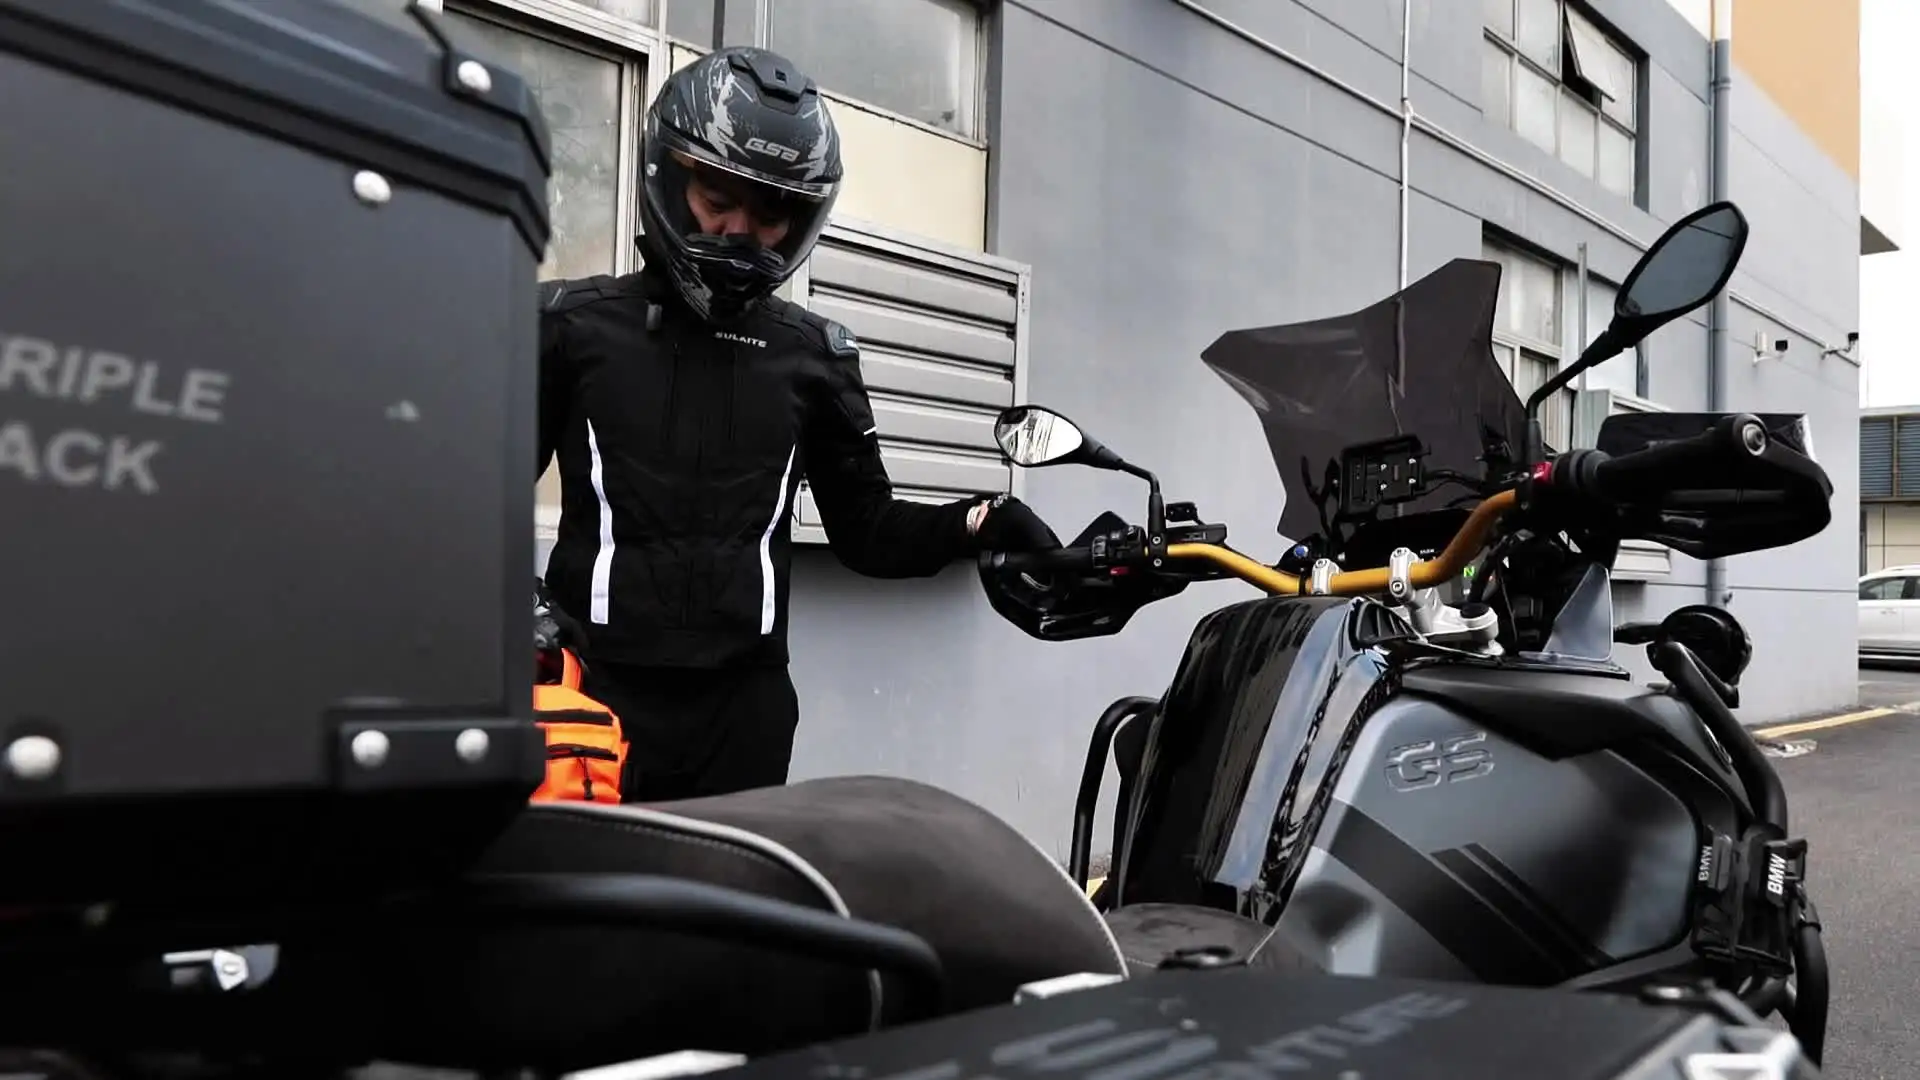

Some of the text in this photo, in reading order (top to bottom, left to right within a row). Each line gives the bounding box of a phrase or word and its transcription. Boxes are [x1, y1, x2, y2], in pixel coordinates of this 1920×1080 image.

[715, 331, 767, 348] SULAITE
[1463, 566, 1475, 578] N
[1384, 732, 1495, 793] GS
[1698, 845, 1713, 881] BMW
[1767, 853, 1787, 895] BMW
